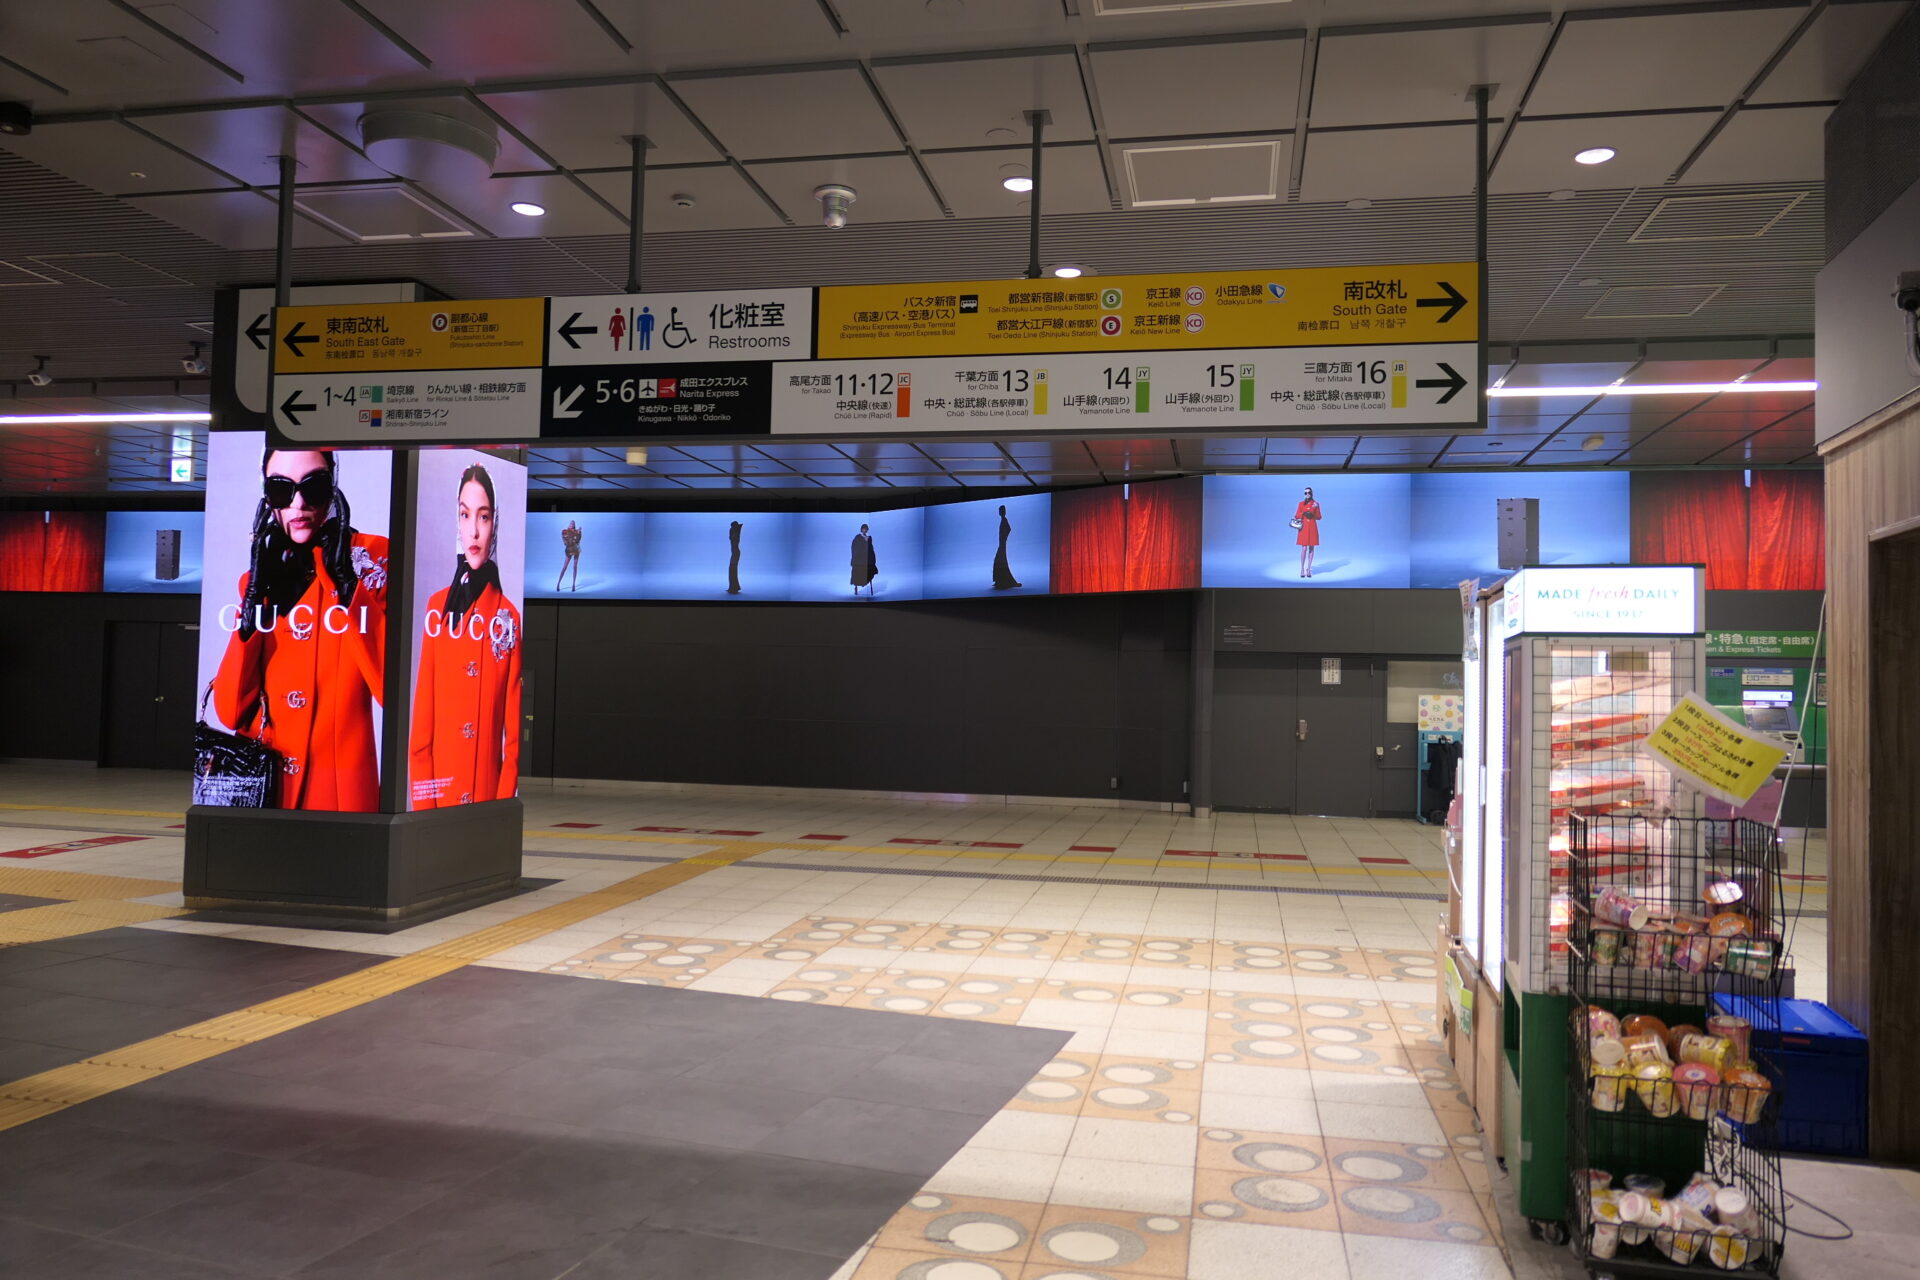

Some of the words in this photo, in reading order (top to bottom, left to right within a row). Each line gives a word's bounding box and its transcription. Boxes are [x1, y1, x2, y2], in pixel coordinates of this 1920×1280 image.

[1145, 287, 1181, 299] 京王線
[1215, 284, 1263, 297] 小田急線
[1343, 279, 1408, 301] 南改札
[903, 295, 957, 307] バスタ新宿
[1216, 298, 1246, 307] Odakyu
[1248, 297, 1263, 305] Line
[1043, 304, 1072, 312] (Shinjuku
[1073, 303, 1099, 311] Station)
[1332, 304, 1372, 317] South
[1375, 303, 1407, 315] Gate
[450, 312, 488, 323] 副都心線
[709, 302, 785, 330] 化粧室
[853, 308, 956, 323] （高速バス・空港バス）
[1134, 314, 1181, 327] 京王新線
[326, 316, 389, 334] 東南改札
[842, 324, 871, 332] Shinjuku
[872, 323, 911, 331] Expressway
[928, 321, 956, 329] Terminal
[1297, 320, 1340, 331] 南检票口
[840, 332, 877, 340] (Expressway
[894, 330, 915, 338] Airport
[916, 329, 940, 338] Express
[987, 332, 1001, 340] Toei
[1038, 331, 1070, 339] (Shinjuku
[326, 337, 354, 347] South
[358, 336, 379, 347] East
[381, 336, 405, 346] Gate
[708, 334, 790, 350] Restrooms
[1242, 367, 1252, 375] JY
[1303, 361, 1353, 374] 三鷹方面
[1356, 360, 1387, 384] 16
[1394, 363, 1404, 372] JB
[954, 370, 998, 382] 千葉方面
[1103, 367, 1132, 390] 14
[1138, 369, 1148, 378] JY
[1206, 364, 1235, 388] 15
[679, 377, 749, 387] 成田エクスプレス
[789, 374, 832, 386] 高尾方面
[1002, 369, 1029, 392] 13
[386, 385, 415, 395] 埼京線
[427, 383, 527, 395] りんかい線・相鉄線方面
[679, 390, 704, 398] Narita
[706, 389, 740, 398] Express
[1079, 407, 1114, 415] Yamanote
[1116, 406, 1131, 414] Line
[1181, 405, 1217, 413] Yamanote
[1219, 404, 1235, 412] Line
[1343, 402, 1359, 410] Line
[1360, 402, 1386, 411] (Local)
[386, 409, 449, 420] 湘南新宿ライン
[868, 411, 893, 420] (Rapid)
[988, 409, 1005, 417] Line
[1005, 408, 1029, 417] (Local)
[638, 415, 672, 424] Kinugawa
[702, 413, 731, 422] Odoriko
[1537, 588, 1582, 600] MADE
[1587, 585, 1630, 604] fresh
[1633, 588, 1680, 600] DAILY
[218, 603, 369, 634] GUCCI
[424, 608, 514, 641] GUCCI
[1726, 646, 1755, 654] Express
[1757, 646, 1782, 654] Tickets
